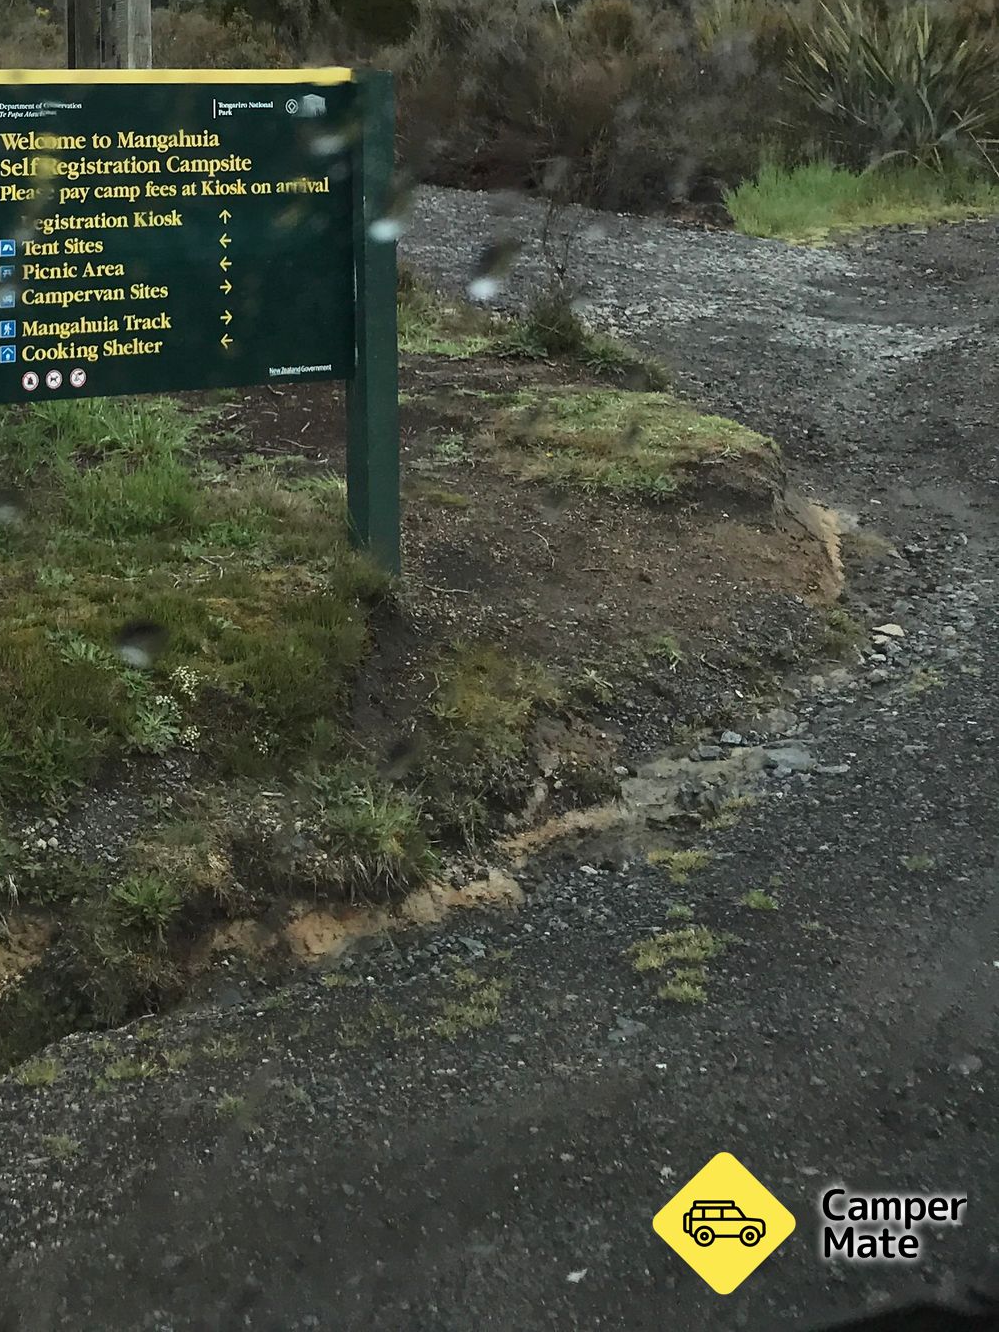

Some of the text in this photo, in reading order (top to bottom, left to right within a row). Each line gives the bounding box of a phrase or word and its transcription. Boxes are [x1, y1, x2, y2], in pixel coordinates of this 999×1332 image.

[0, 102, 83, 111] Department of Cervation
[7, 111, 24, 119] Papa
[24, 110, 57, 118] Ataw
[218, 100, 274, 110] Tongariro National
[0, 129, 221, 153] Welcome to Mangahuia
[0, 156, 40, 177] Self
[166, 154, 252, 178] Campsite
[59, 186, 91, 205] pay
[94, 184, 141, 203] camp
[144, 181, 177, 198] fees
[181, 181, 198, 197] at
[201, 178, 248, 196] Kiosk
[251, 182, 272, 195] on
[275, 176, 330, 195] arrival
[21, 209, 183, 235] egistration Kiosk
[22, 237, 104, 257] Tent Sites
[22, 261, 125, 281] Picnic Area
[21, 283, 169, 308] Campervan Sites
[22, 312, 172, 339] Mangahuia Track
[21, 338, 163, 362] Cooking Shelter
[281, 366, 301, 374] Zealand
[301, 364, 332, 373] Government
